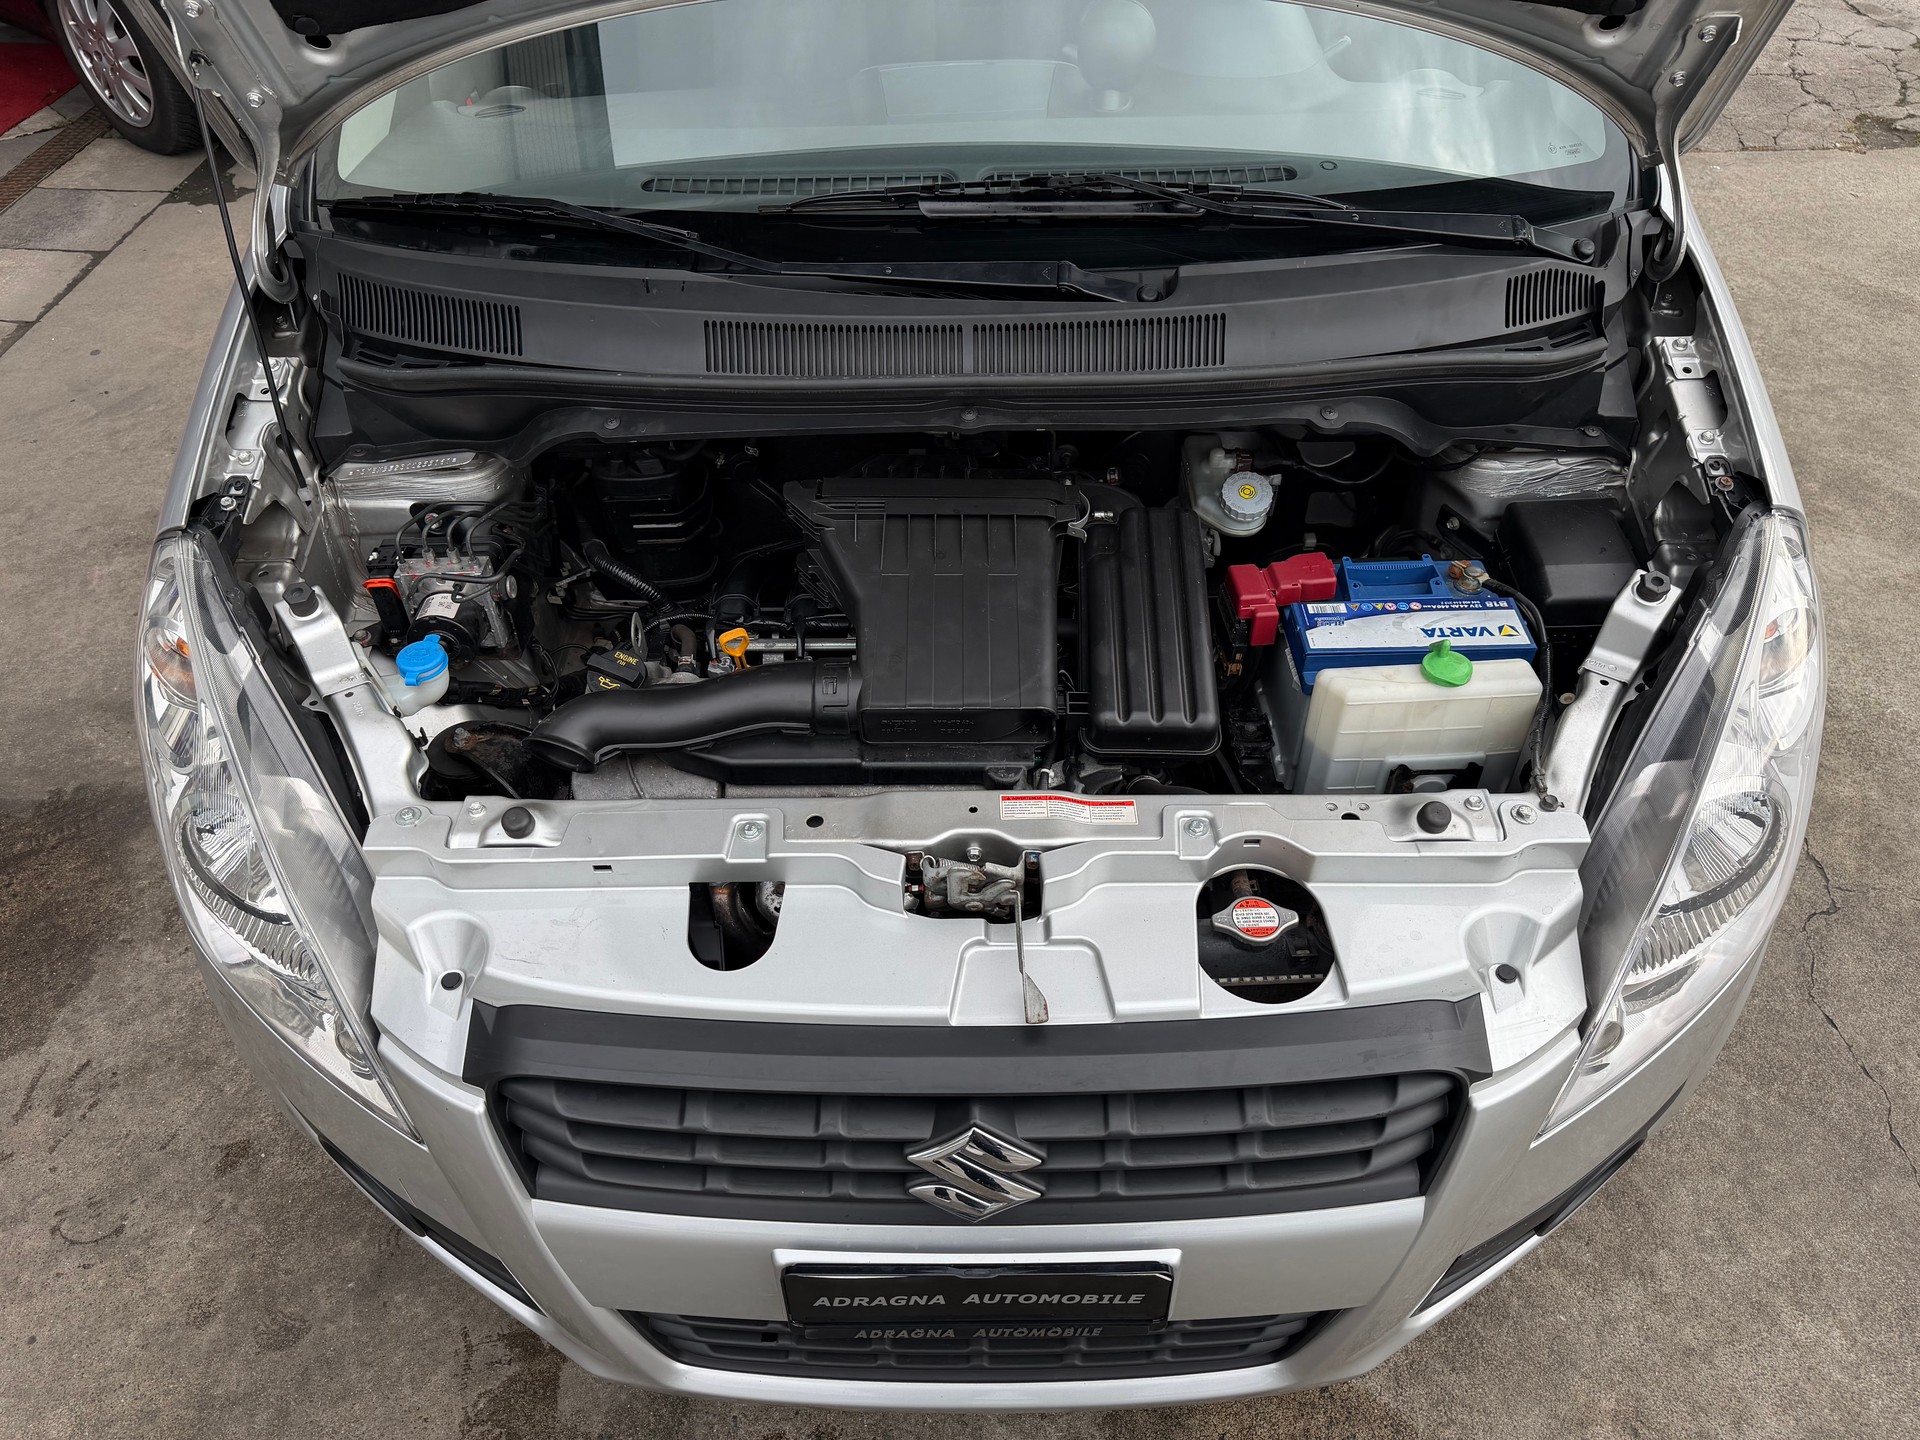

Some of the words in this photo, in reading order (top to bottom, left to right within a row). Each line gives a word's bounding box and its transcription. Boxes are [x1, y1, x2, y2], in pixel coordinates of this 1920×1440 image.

[1484, 600, 1509, 608] B18
[1420, 626, 1495, 639] VARTA
[614, 651, 639, 666] ENGINE
[812, 1294, 947, 1307] ADRAGNA
[962, 1293, 1146, 1305] AUTOMOBILE
[853, 1328, 956, 1340] ADRAGNA
[973, 1326, 1104, 1338] AUTOMOBILE
